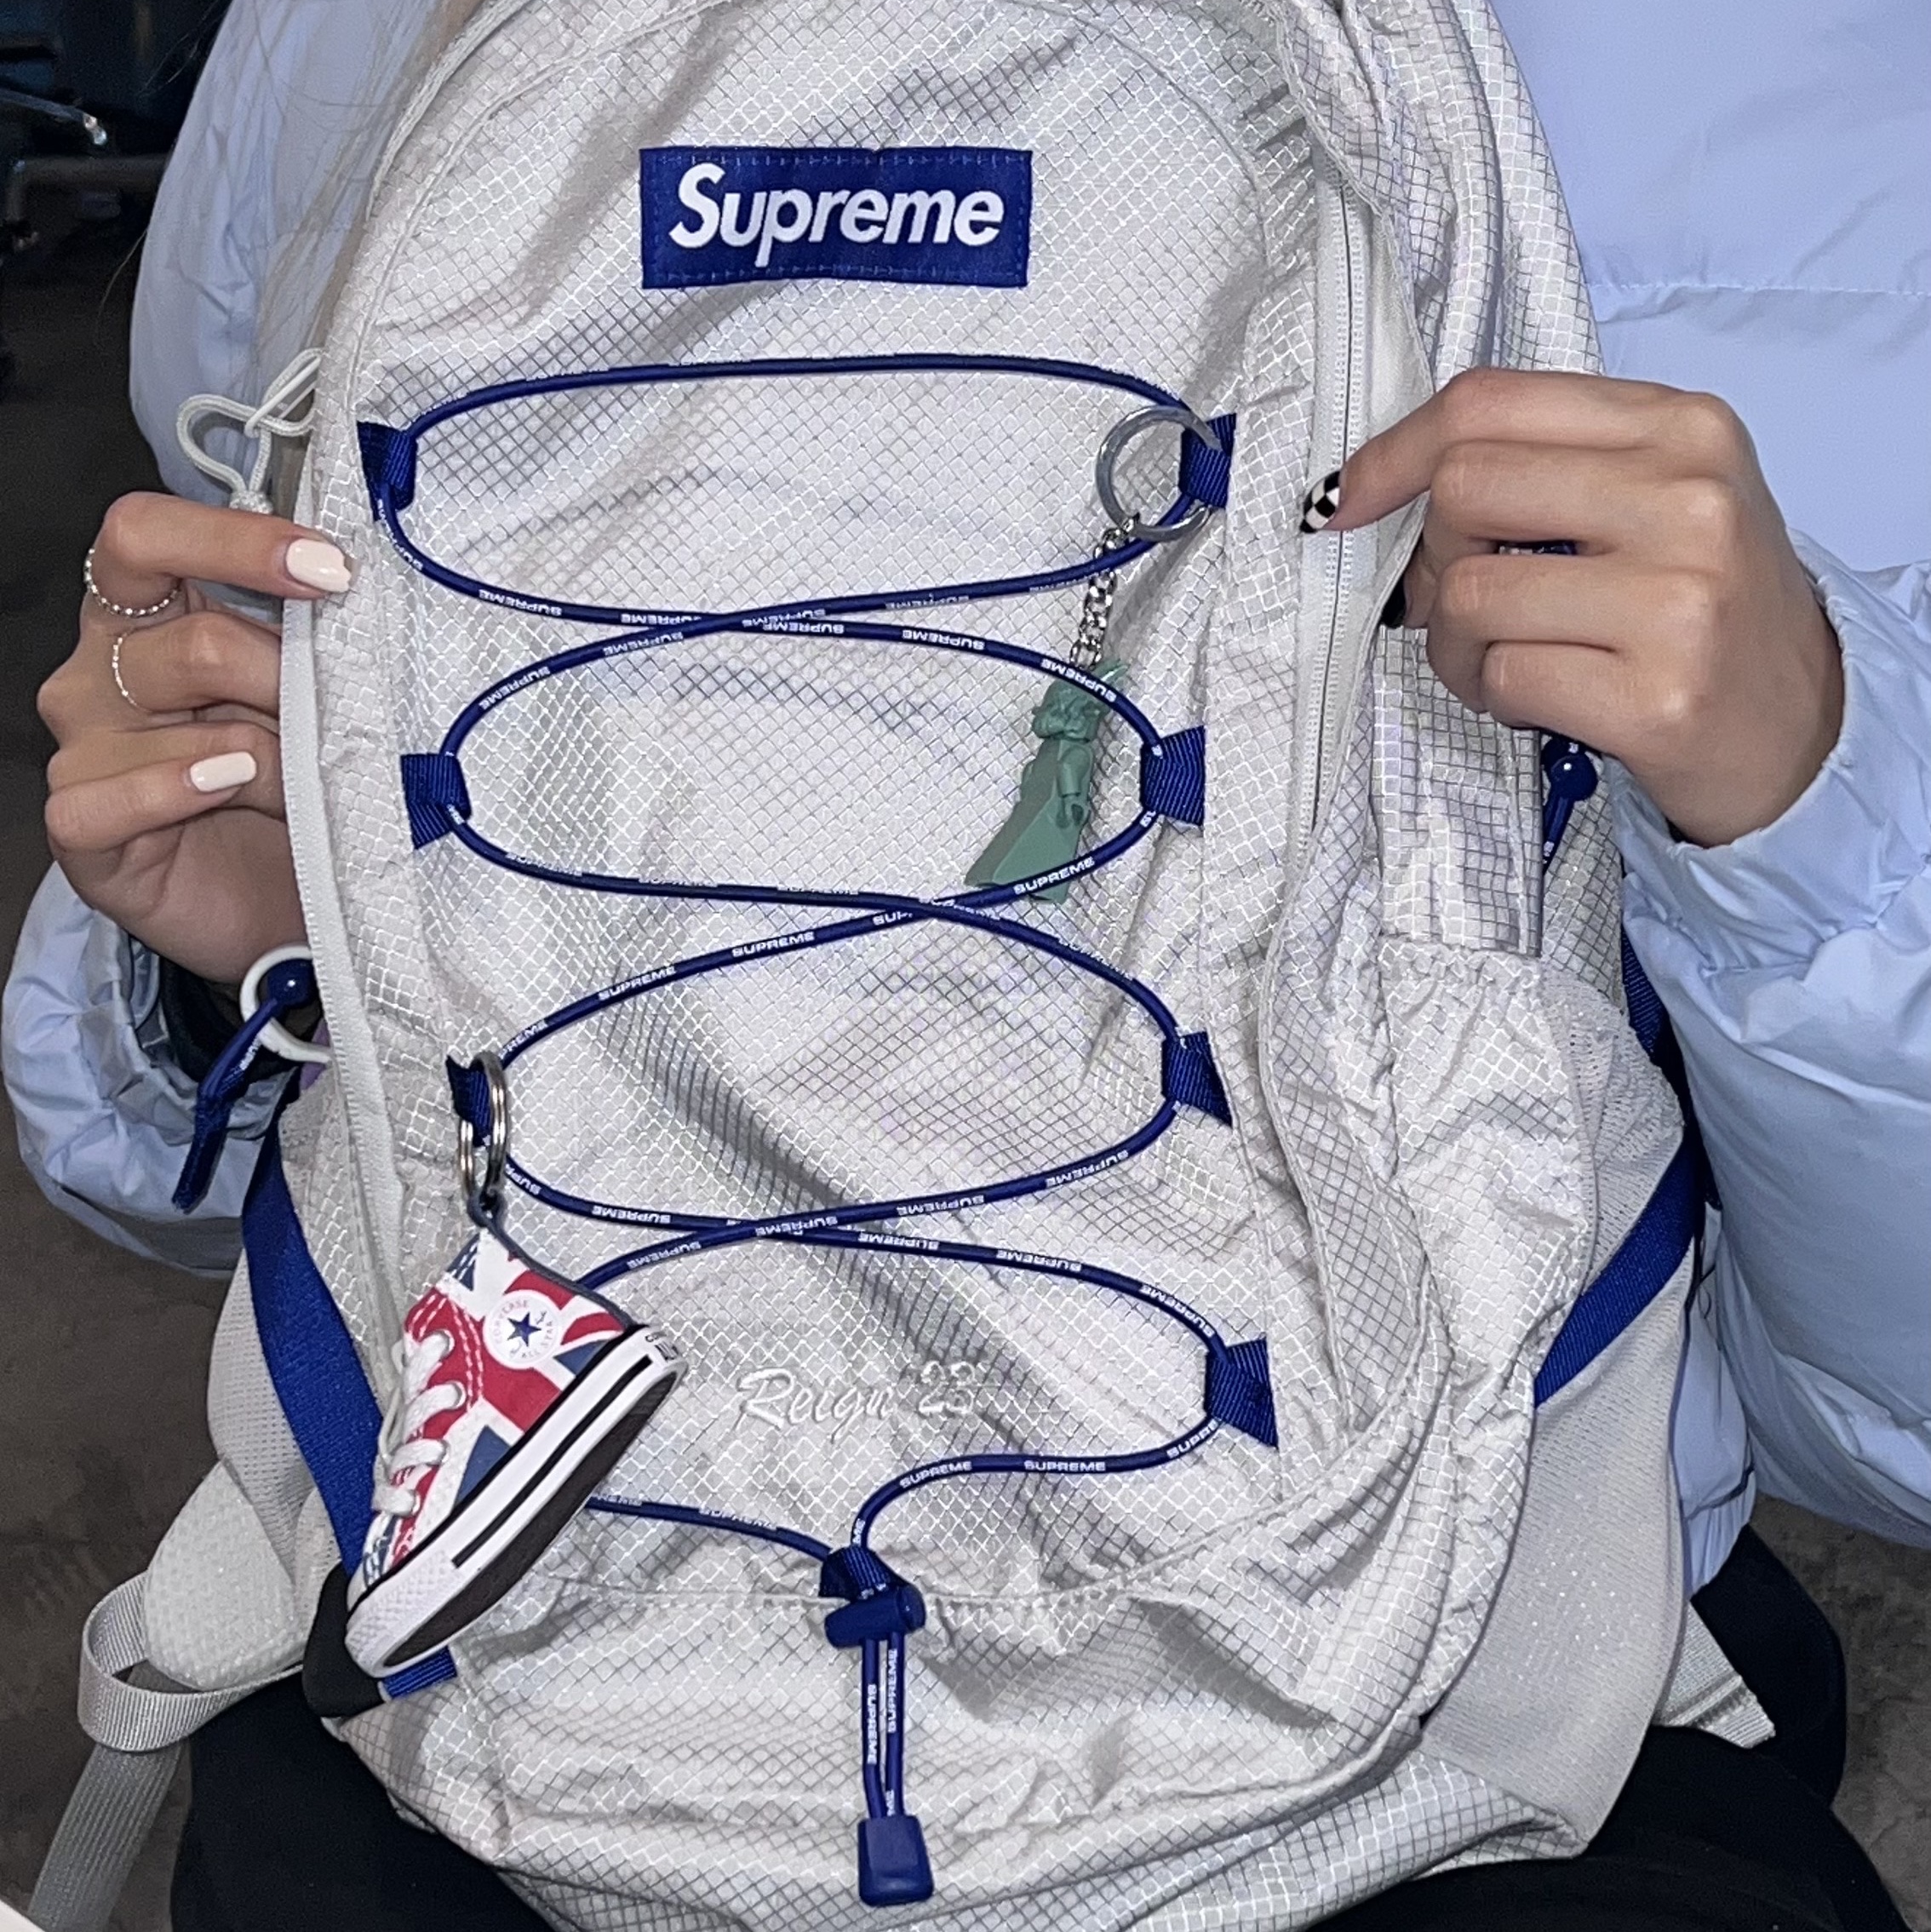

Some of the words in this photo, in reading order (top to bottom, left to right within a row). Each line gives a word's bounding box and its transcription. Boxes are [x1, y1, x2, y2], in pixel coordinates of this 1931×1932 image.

[669, 163, 1004, 267] Supreme
[478, 588, 562, 616] SUPREME
[603, 632, 684, 656] SUPREME
[902, 629, 985, 651] SUPREME
[478, 666, 551, 709] SUPREME
[1040, 658, 1117, 702] SUPREME
[1012, 858, 1096, 894] SUPREME
[732, 932, 815, 957] SUPREME
[599, 966, 676, 1000] SUPREME
[1046, 1149, 1129, 1187] SUPREME
[592, 1205, 671, 1224] SUPREME
[897, 1195, 985, 1217] SUPREME
[755, 1216, 838, 1236] SUPREME
[627, 1241, 702, 1270] SUPREME
[858, 1233, 939, 1250] SUPREME
[995, 1249, 1081, 1272] SUPREME
[1139, 1284, 1216, 1338] SUPREME
[736, 1367, 895, 1444] Reign
[899, 1461, 972, 1488] SUPREME
[1024, 1461, 1106, 1472] SUPREME
[887, 1648, 898, 1734] SUPREME
[868, 1683, 878, 1765] SUPREME
